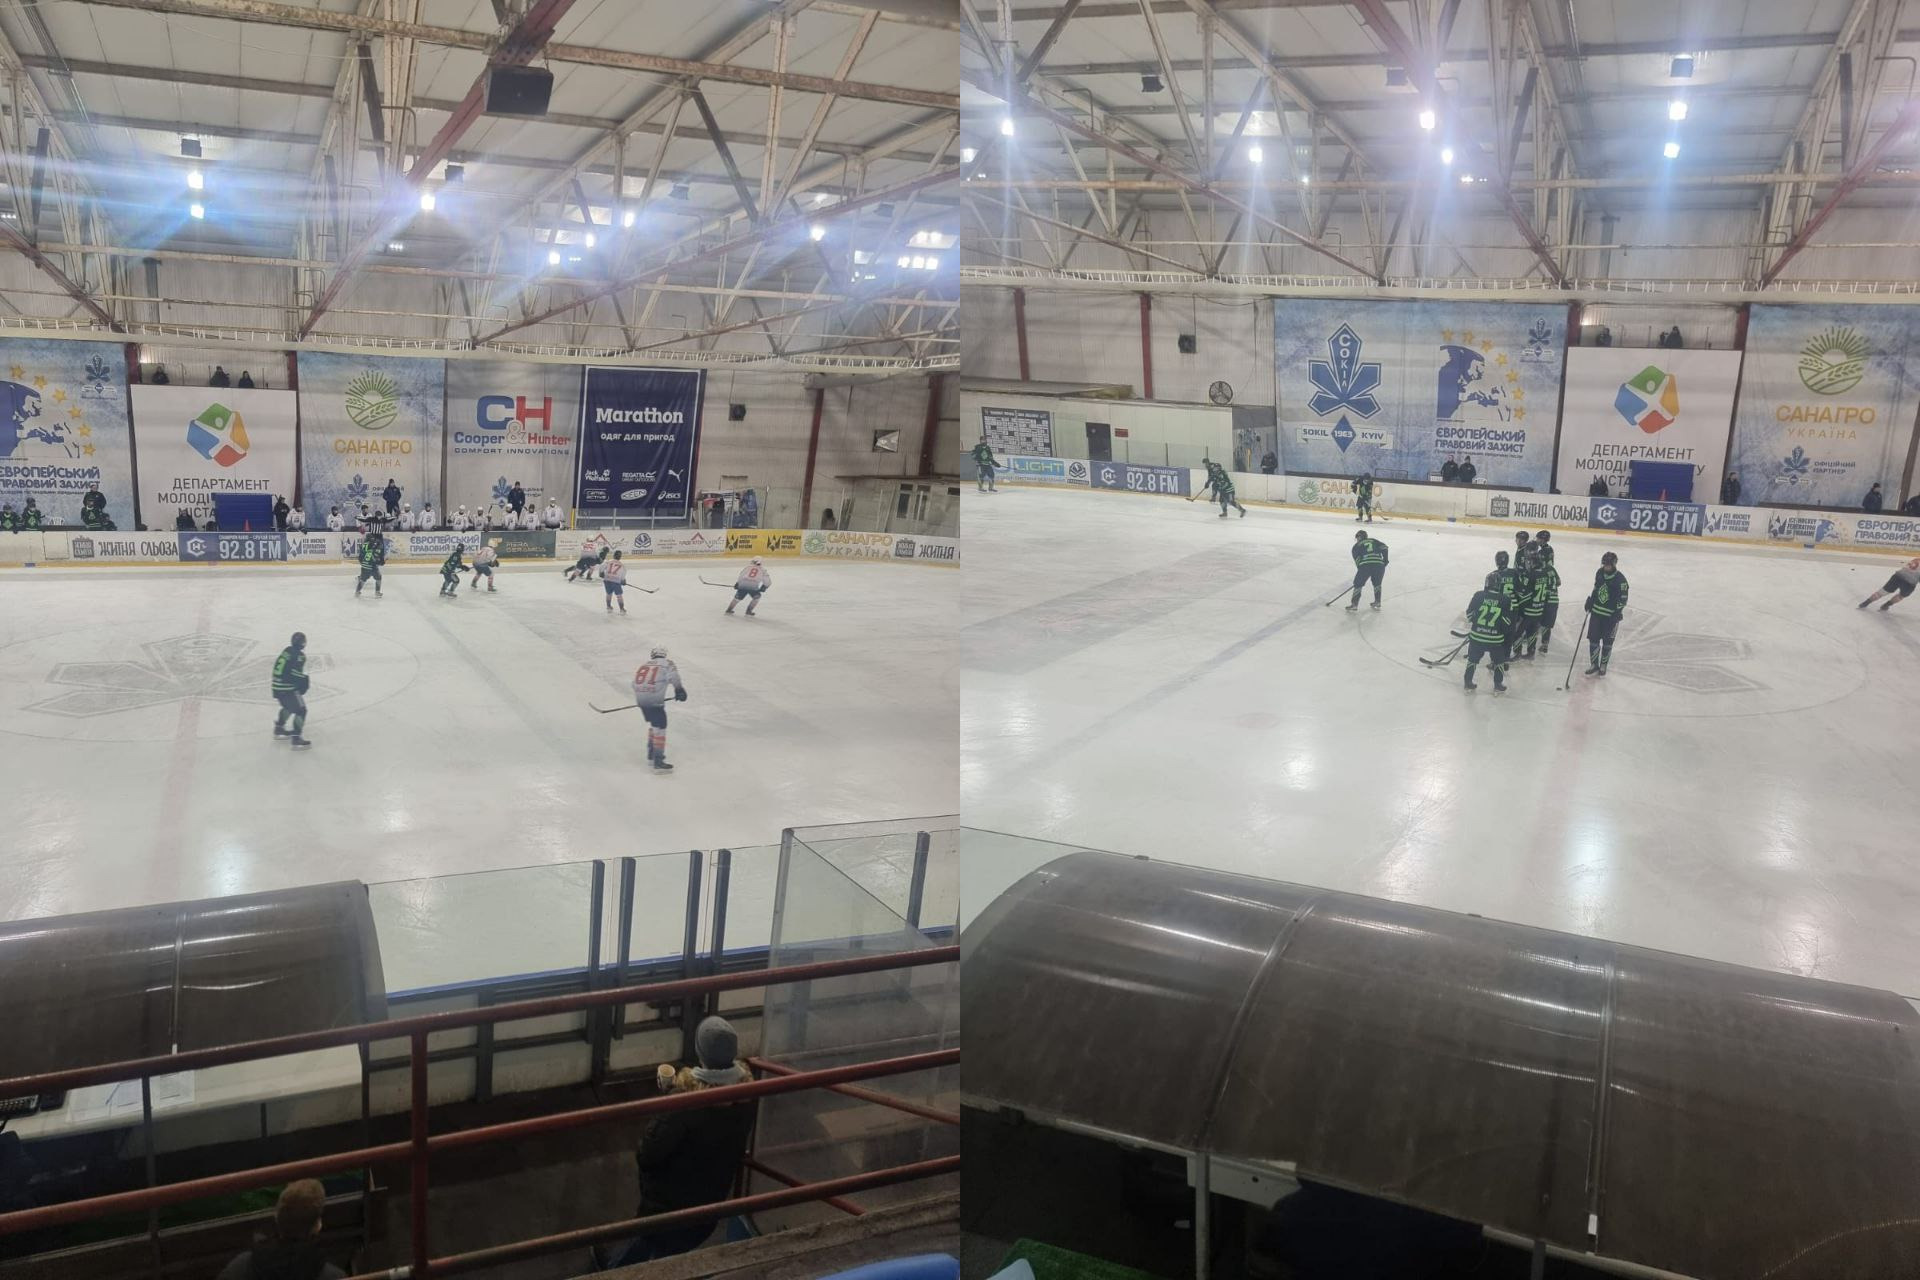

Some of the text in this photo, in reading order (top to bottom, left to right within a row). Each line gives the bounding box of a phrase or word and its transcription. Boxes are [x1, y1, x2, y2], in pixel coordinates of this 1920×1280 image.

[596, 407, 684, 424] Marathon
[1776, 405, 1875, 424] САНАГРО
[454, 432, 505, 446] Cooper
[527, 433, 571, 446] Hunter
[601, 432, 675, 443] одяг для пригод
[1303, 428, 1328, 437] SOKIL
[1361, 432, 1384, 440] KYIV
[1436, 427, 1526, 443] ЄВРОПЕЙСЬКИЙ
[1788, 426, 1856, 440] УКРАЇНА
[334, 439, 412, 454] САНАГРО
[1435, 439, 1525, 453] ПРАВОВИЙ ЗАХИСТ
[1592, 444, 1695, 460] ДЕПАРТАМЕНТ
[346, 457, 402, 468] УКРАЇНА
[1575, 458, 1627, 474] МОЛОДІ
[172, 477, 270, 491] ДЕПАРТАМЕНТ
[1127, 471, 1178, 494] 92.8 FM
[158, 492, 210, 506] МОЛОДІ
[1514, 502, 1588, 522] ЖИТНЯ СЛЬОЗА
[1630, 509, 1698, 533] 92.8 FM
[410, 535, 480, 544] ЄВРОПЕЙСЬКИЙ
[827, 532, 893, 546] САНАГРО
[1855, 530, 1911, 541] ПРАВОВИЙ
[98, 541, 136, 556] ЖИТНЯ
[140, 541, 179, 556] СЛЬОЗА
[219, 540, 281, 559] 92.8 FM
[826, 546, 891, 559] УКРАЇНА
[918, 544, 955, 559] ЖИТНЯ
[749, 567, 757, 578] 8
[1477, 605, 1501, 627] 27
[636, 665, 659, 685] 81
